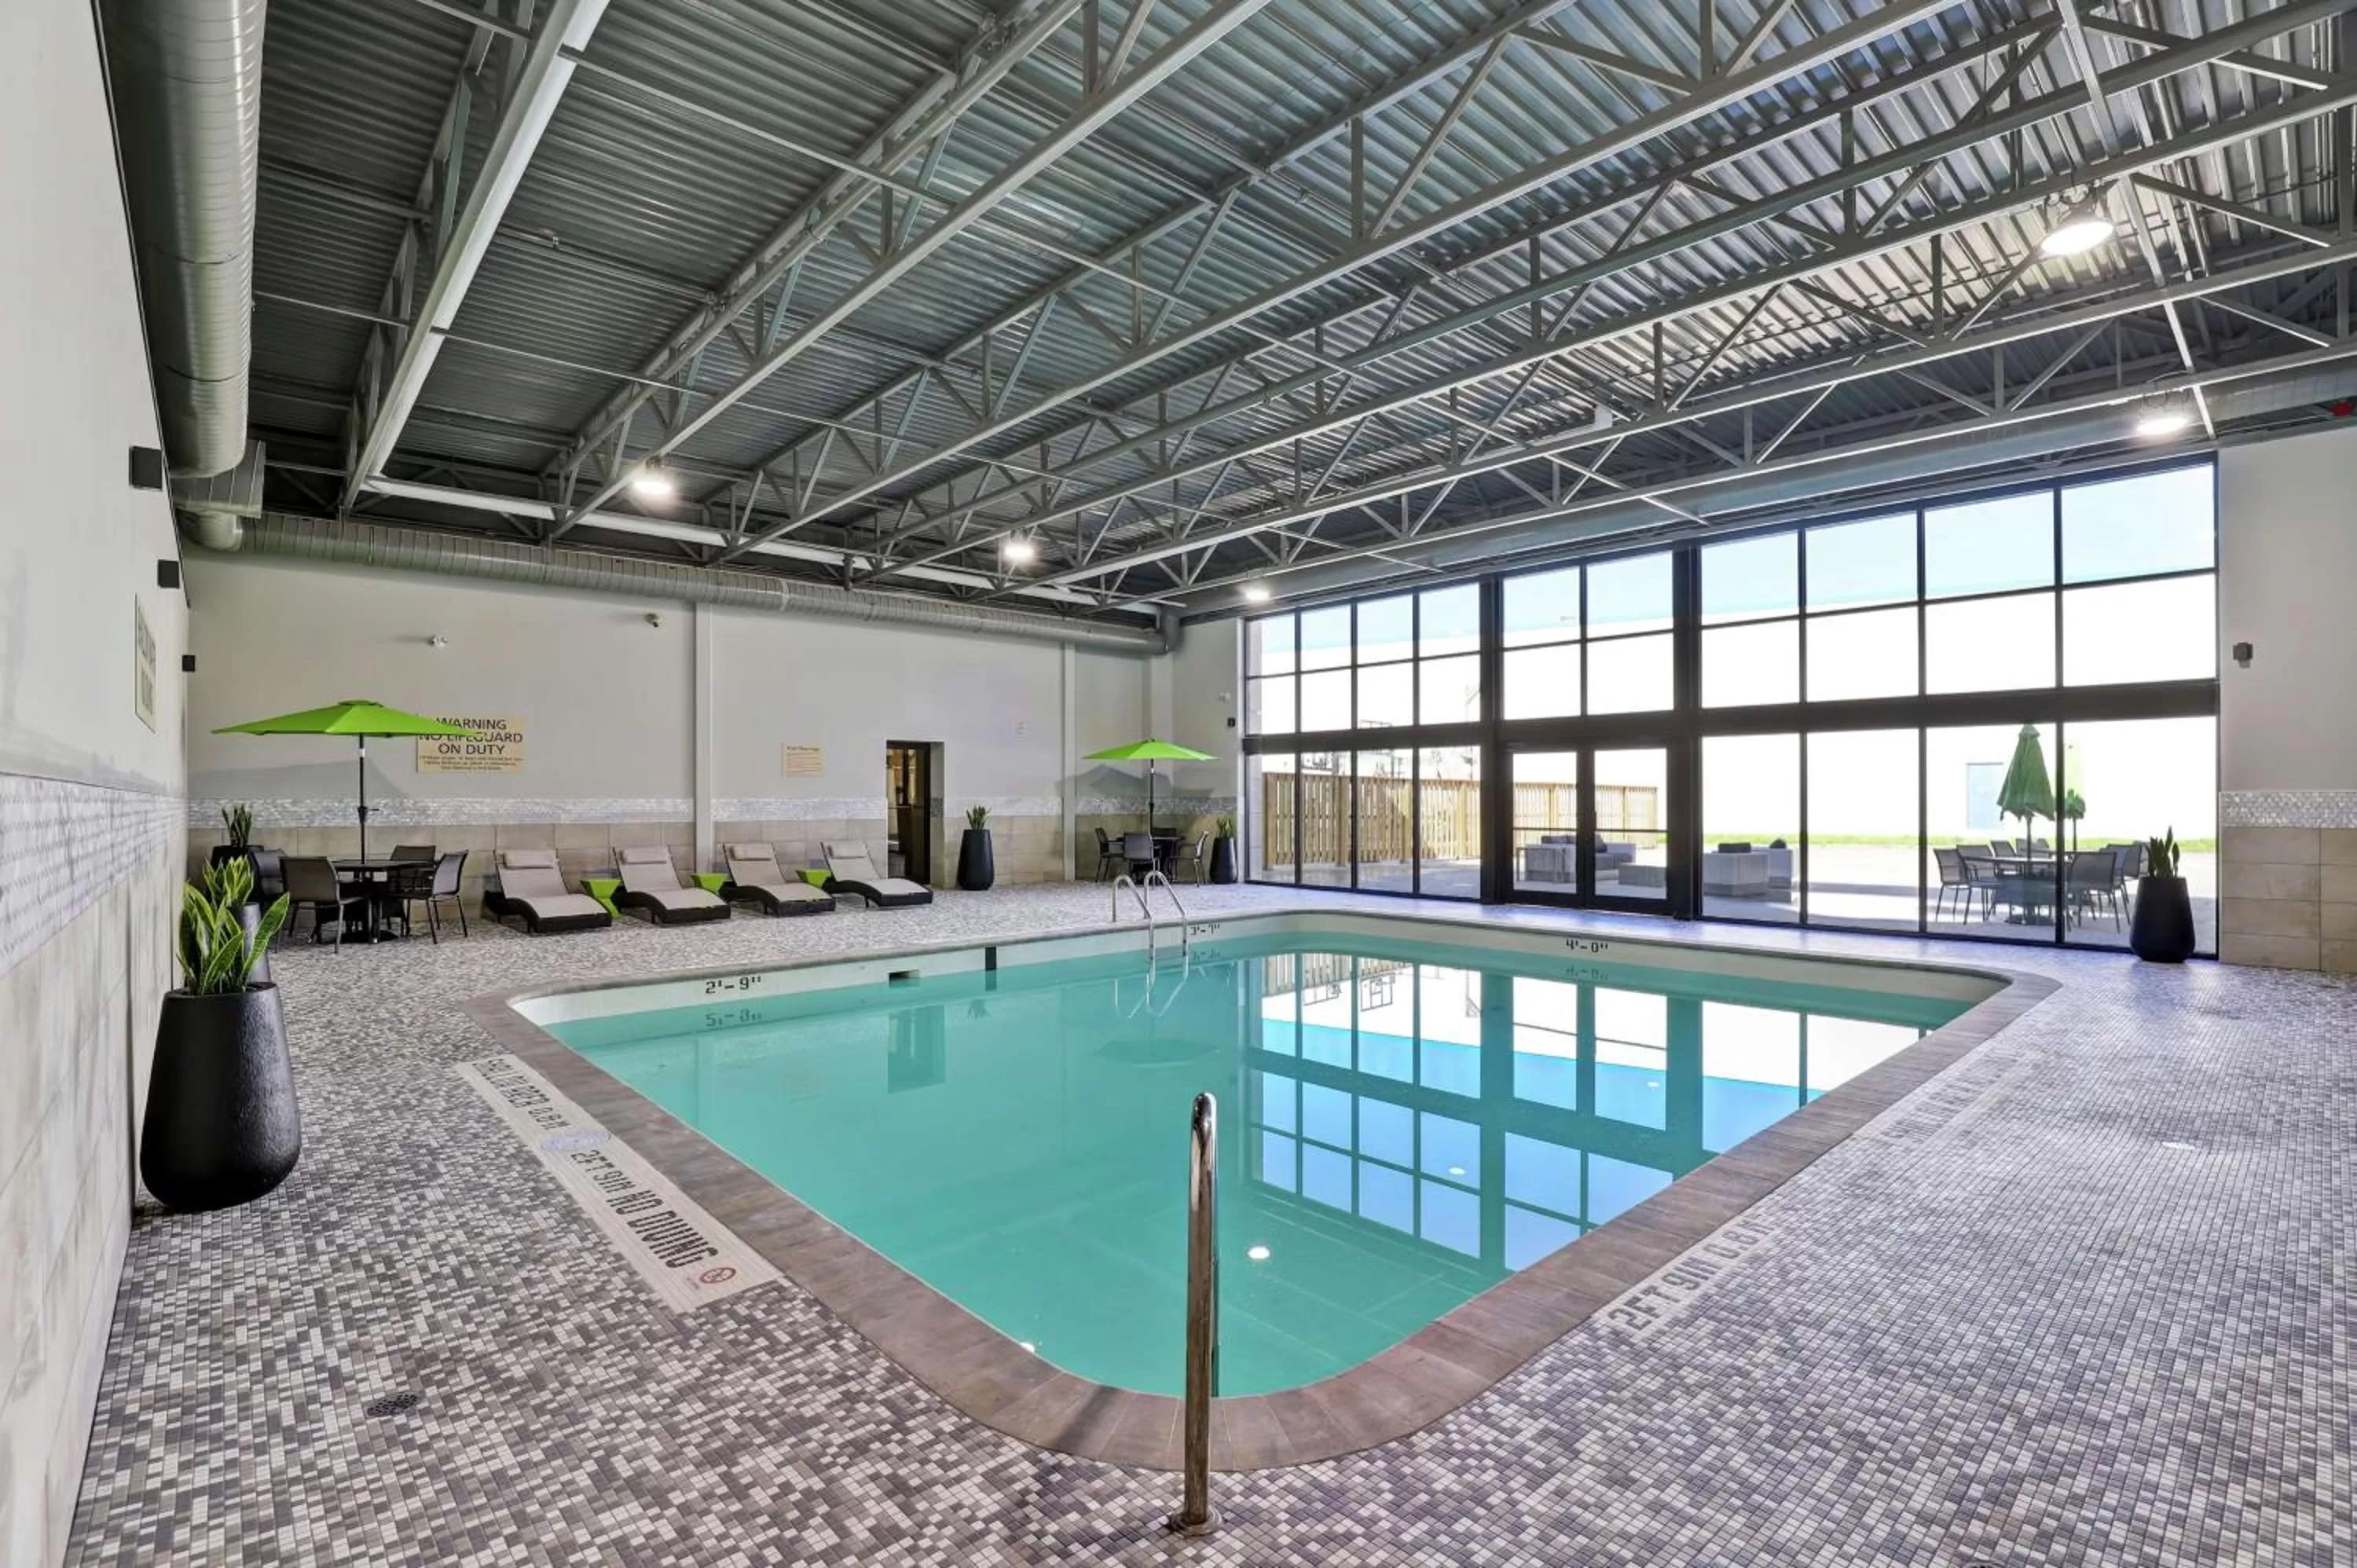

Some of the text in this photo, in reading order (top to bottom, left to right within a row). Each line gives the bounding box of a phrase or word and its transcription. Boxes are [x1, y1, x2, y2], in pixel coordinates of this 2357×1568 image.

[435, 717, 507, 730] WARNING
[438, 742, 504, 755] ON DUTY
[593, 1170, 636, 1193] 9IN
[606, 1189, 664, 1214] NO
[627, 1211, 719, 1268] DIVING
[1608, 1284, 1681, 1330] 2FT
[1661, 1258, 1724, 1290] 9IN
